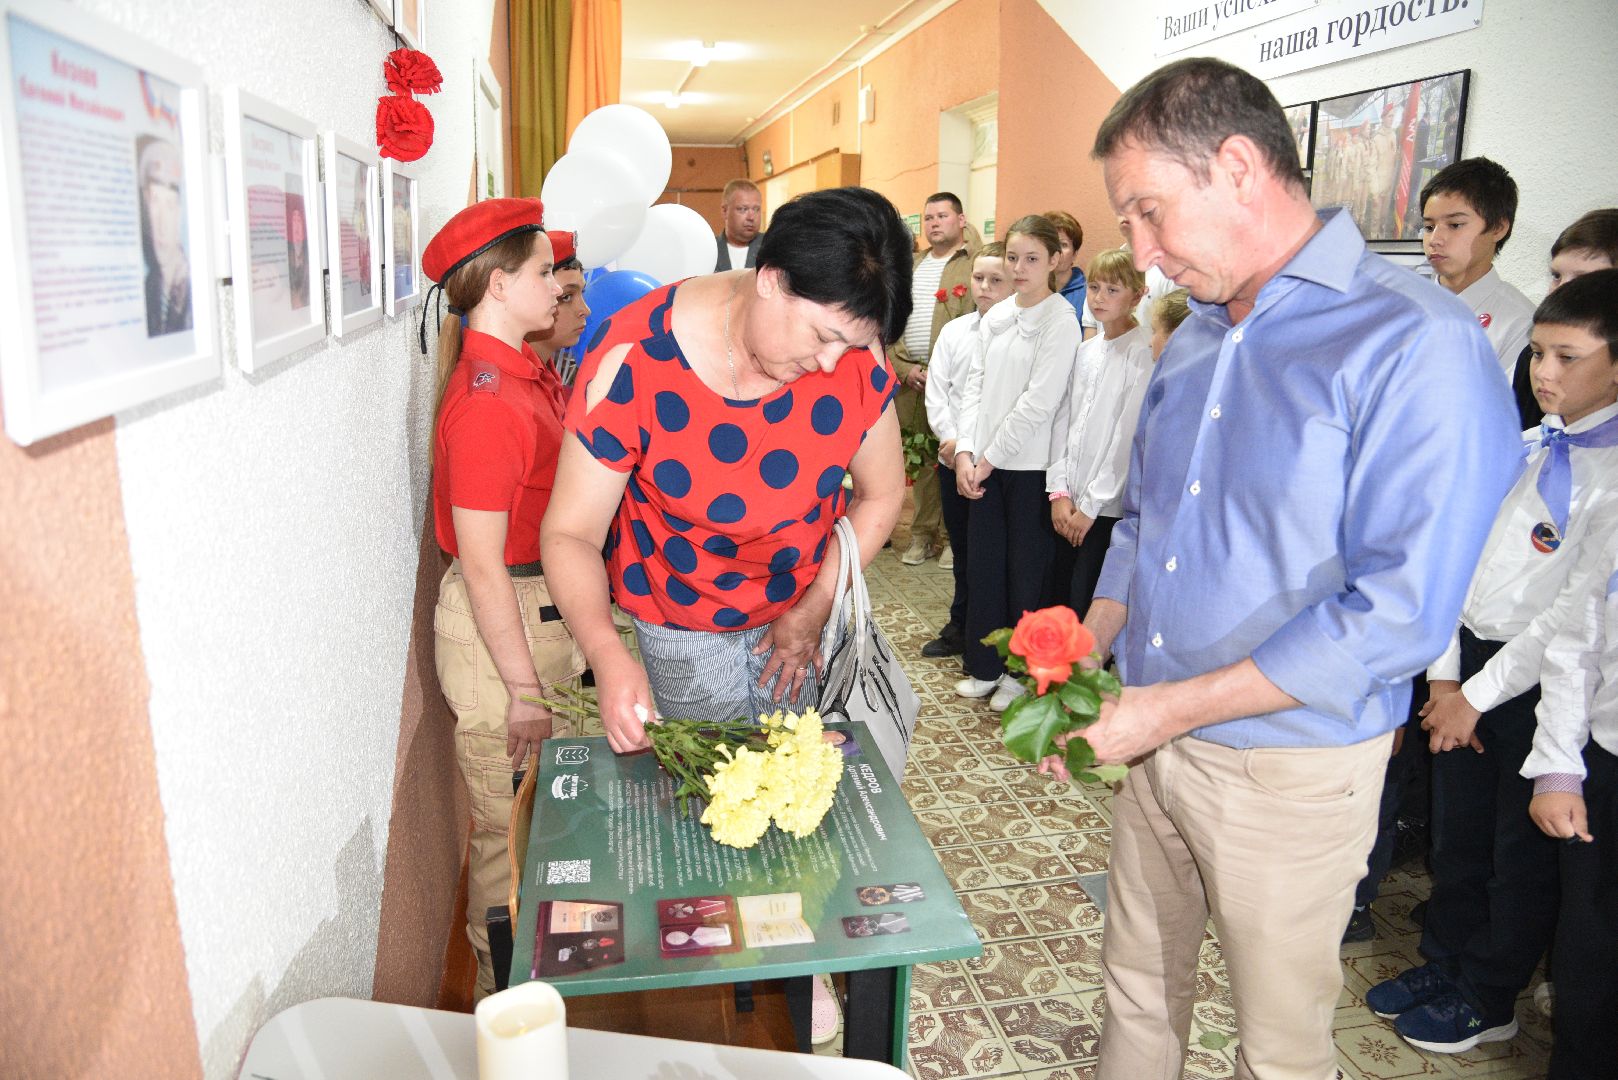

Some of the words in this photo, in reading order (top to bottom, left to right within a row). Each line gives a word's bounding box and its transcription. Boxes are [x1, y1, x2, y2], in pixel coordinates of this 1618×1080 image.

[1164, 7, 1209, 40] Ваши
[1212, 0, 1276, 31] успе
[1259, 26, 1319, 63] наша
[1325, 0, 1469, 47] гордость
[859, 763, 882, 794] КЕДРОВ
[858, 790, 888, 841] Александрович
